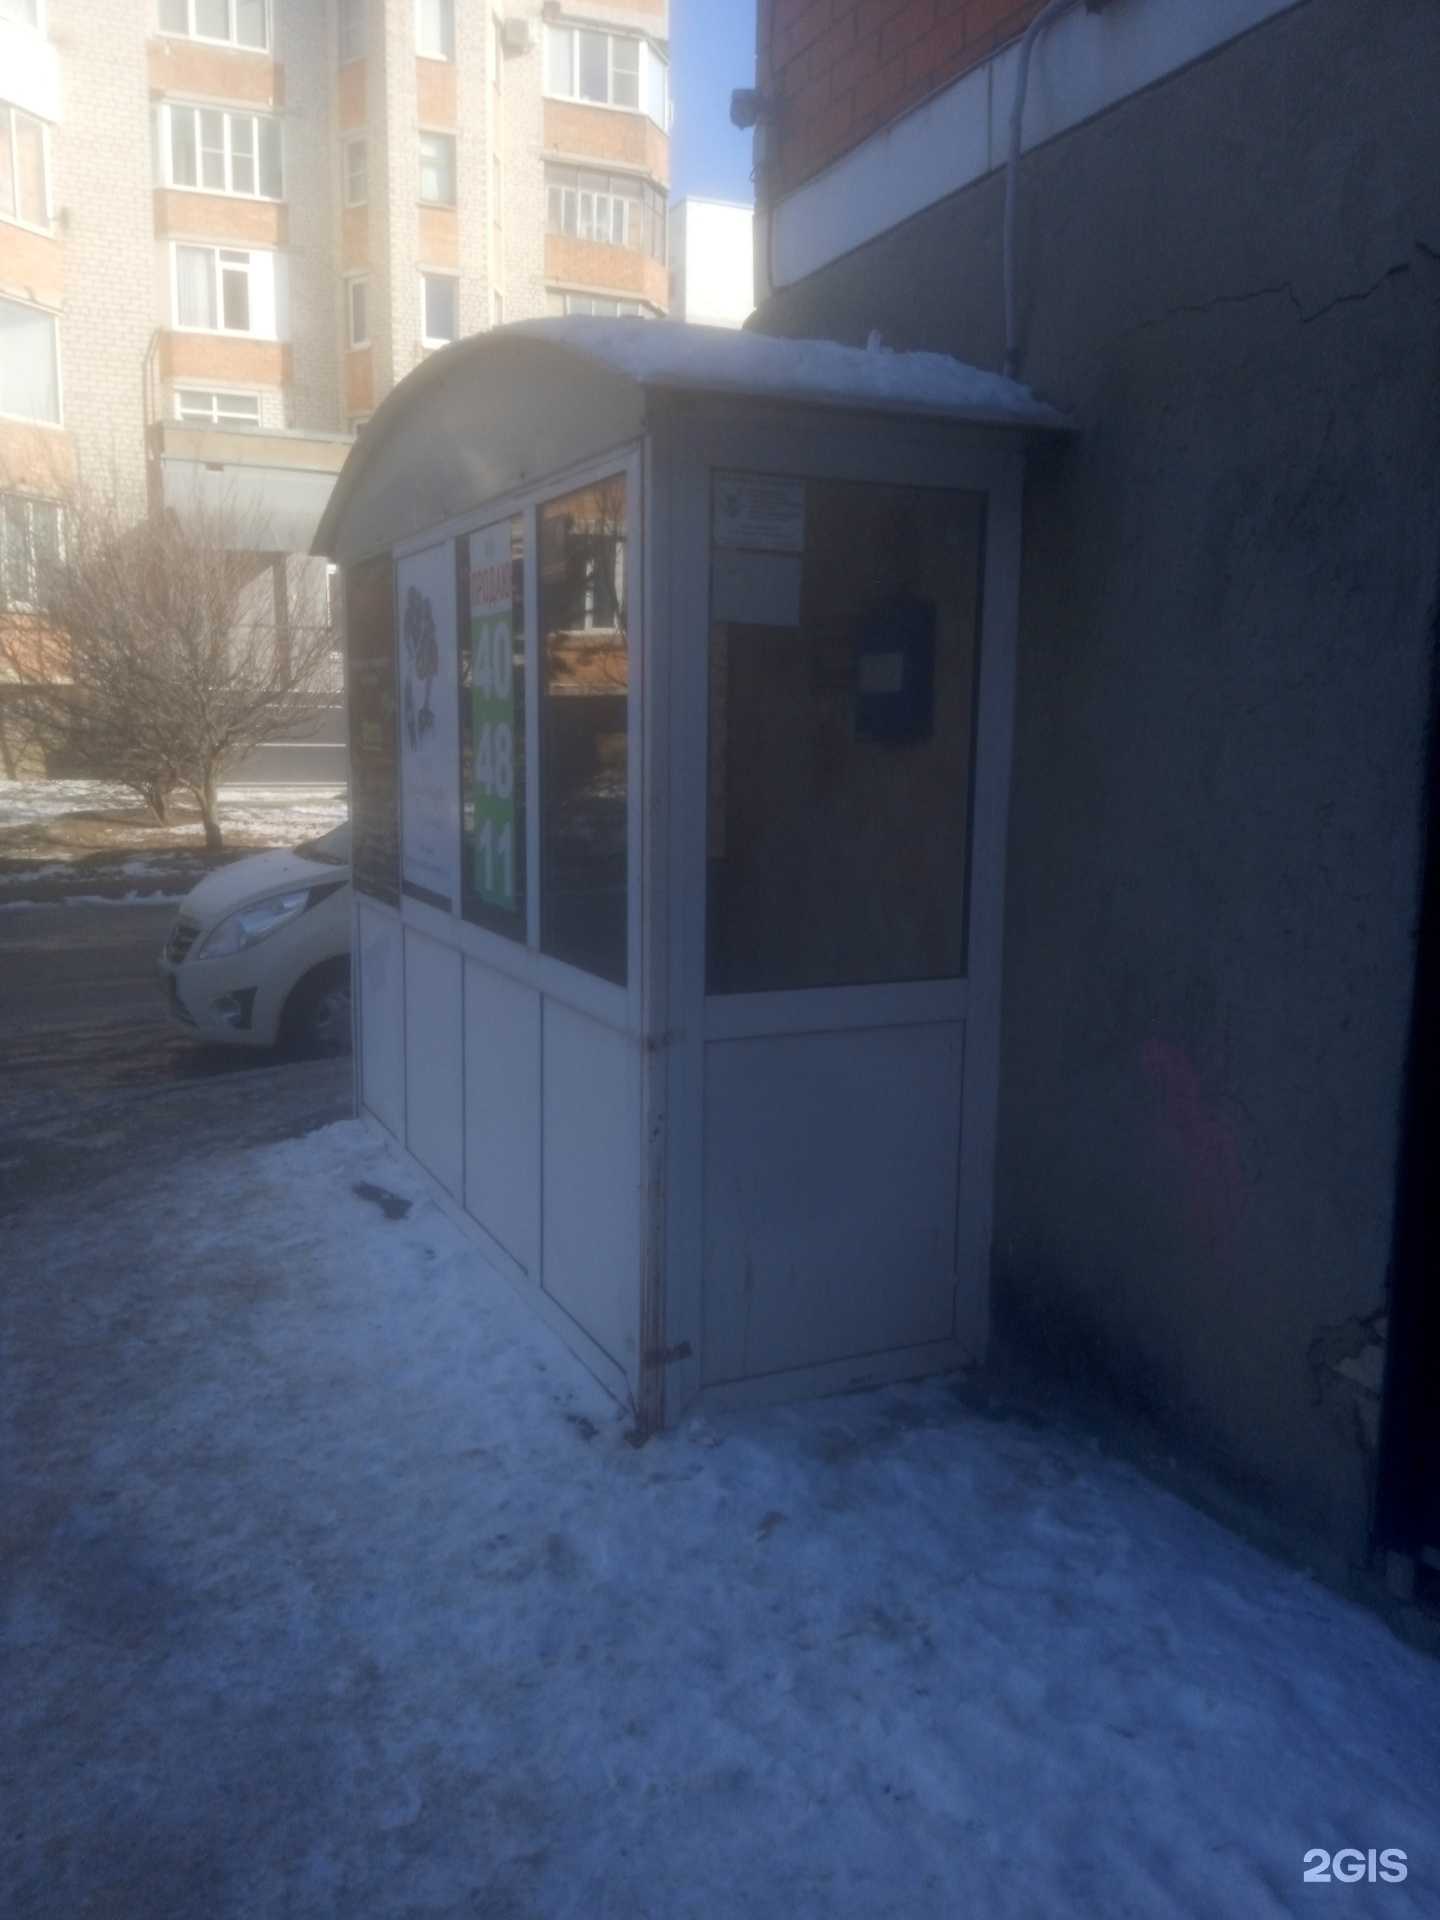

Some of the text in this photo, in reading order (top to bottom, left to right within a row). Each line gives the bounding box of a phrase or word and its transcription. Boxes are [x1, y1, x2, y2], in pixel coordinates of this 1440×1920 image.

[473, 620, 513, 701] 40
[474, 722, 513, 800] 48
[478, 818, 513, 898] 11
